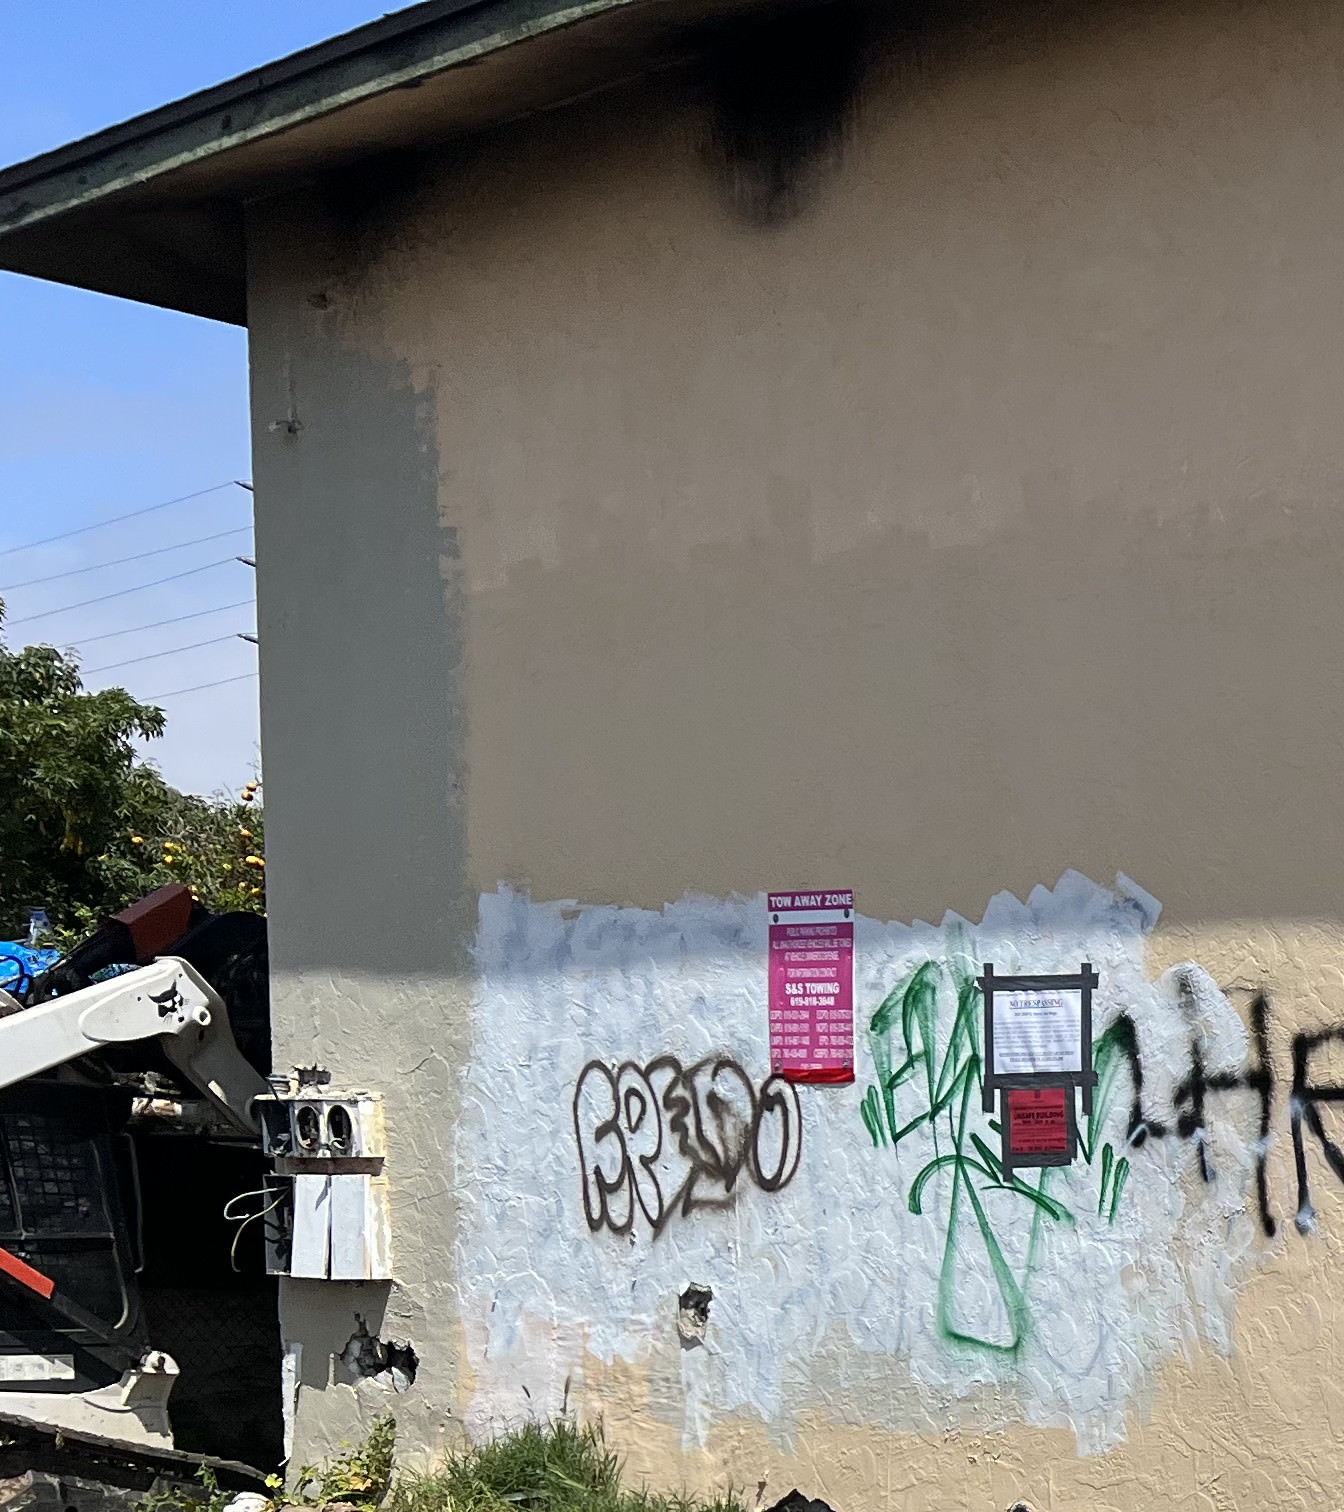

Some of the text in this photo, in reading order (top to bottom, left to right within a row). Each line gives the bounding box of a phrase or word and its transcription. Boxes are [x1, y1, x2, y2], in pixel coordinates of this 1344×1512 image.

[769, 893, 852, 908] TOW AWAY ZONE
[785, 982, 840, 995] S&S TOWING
